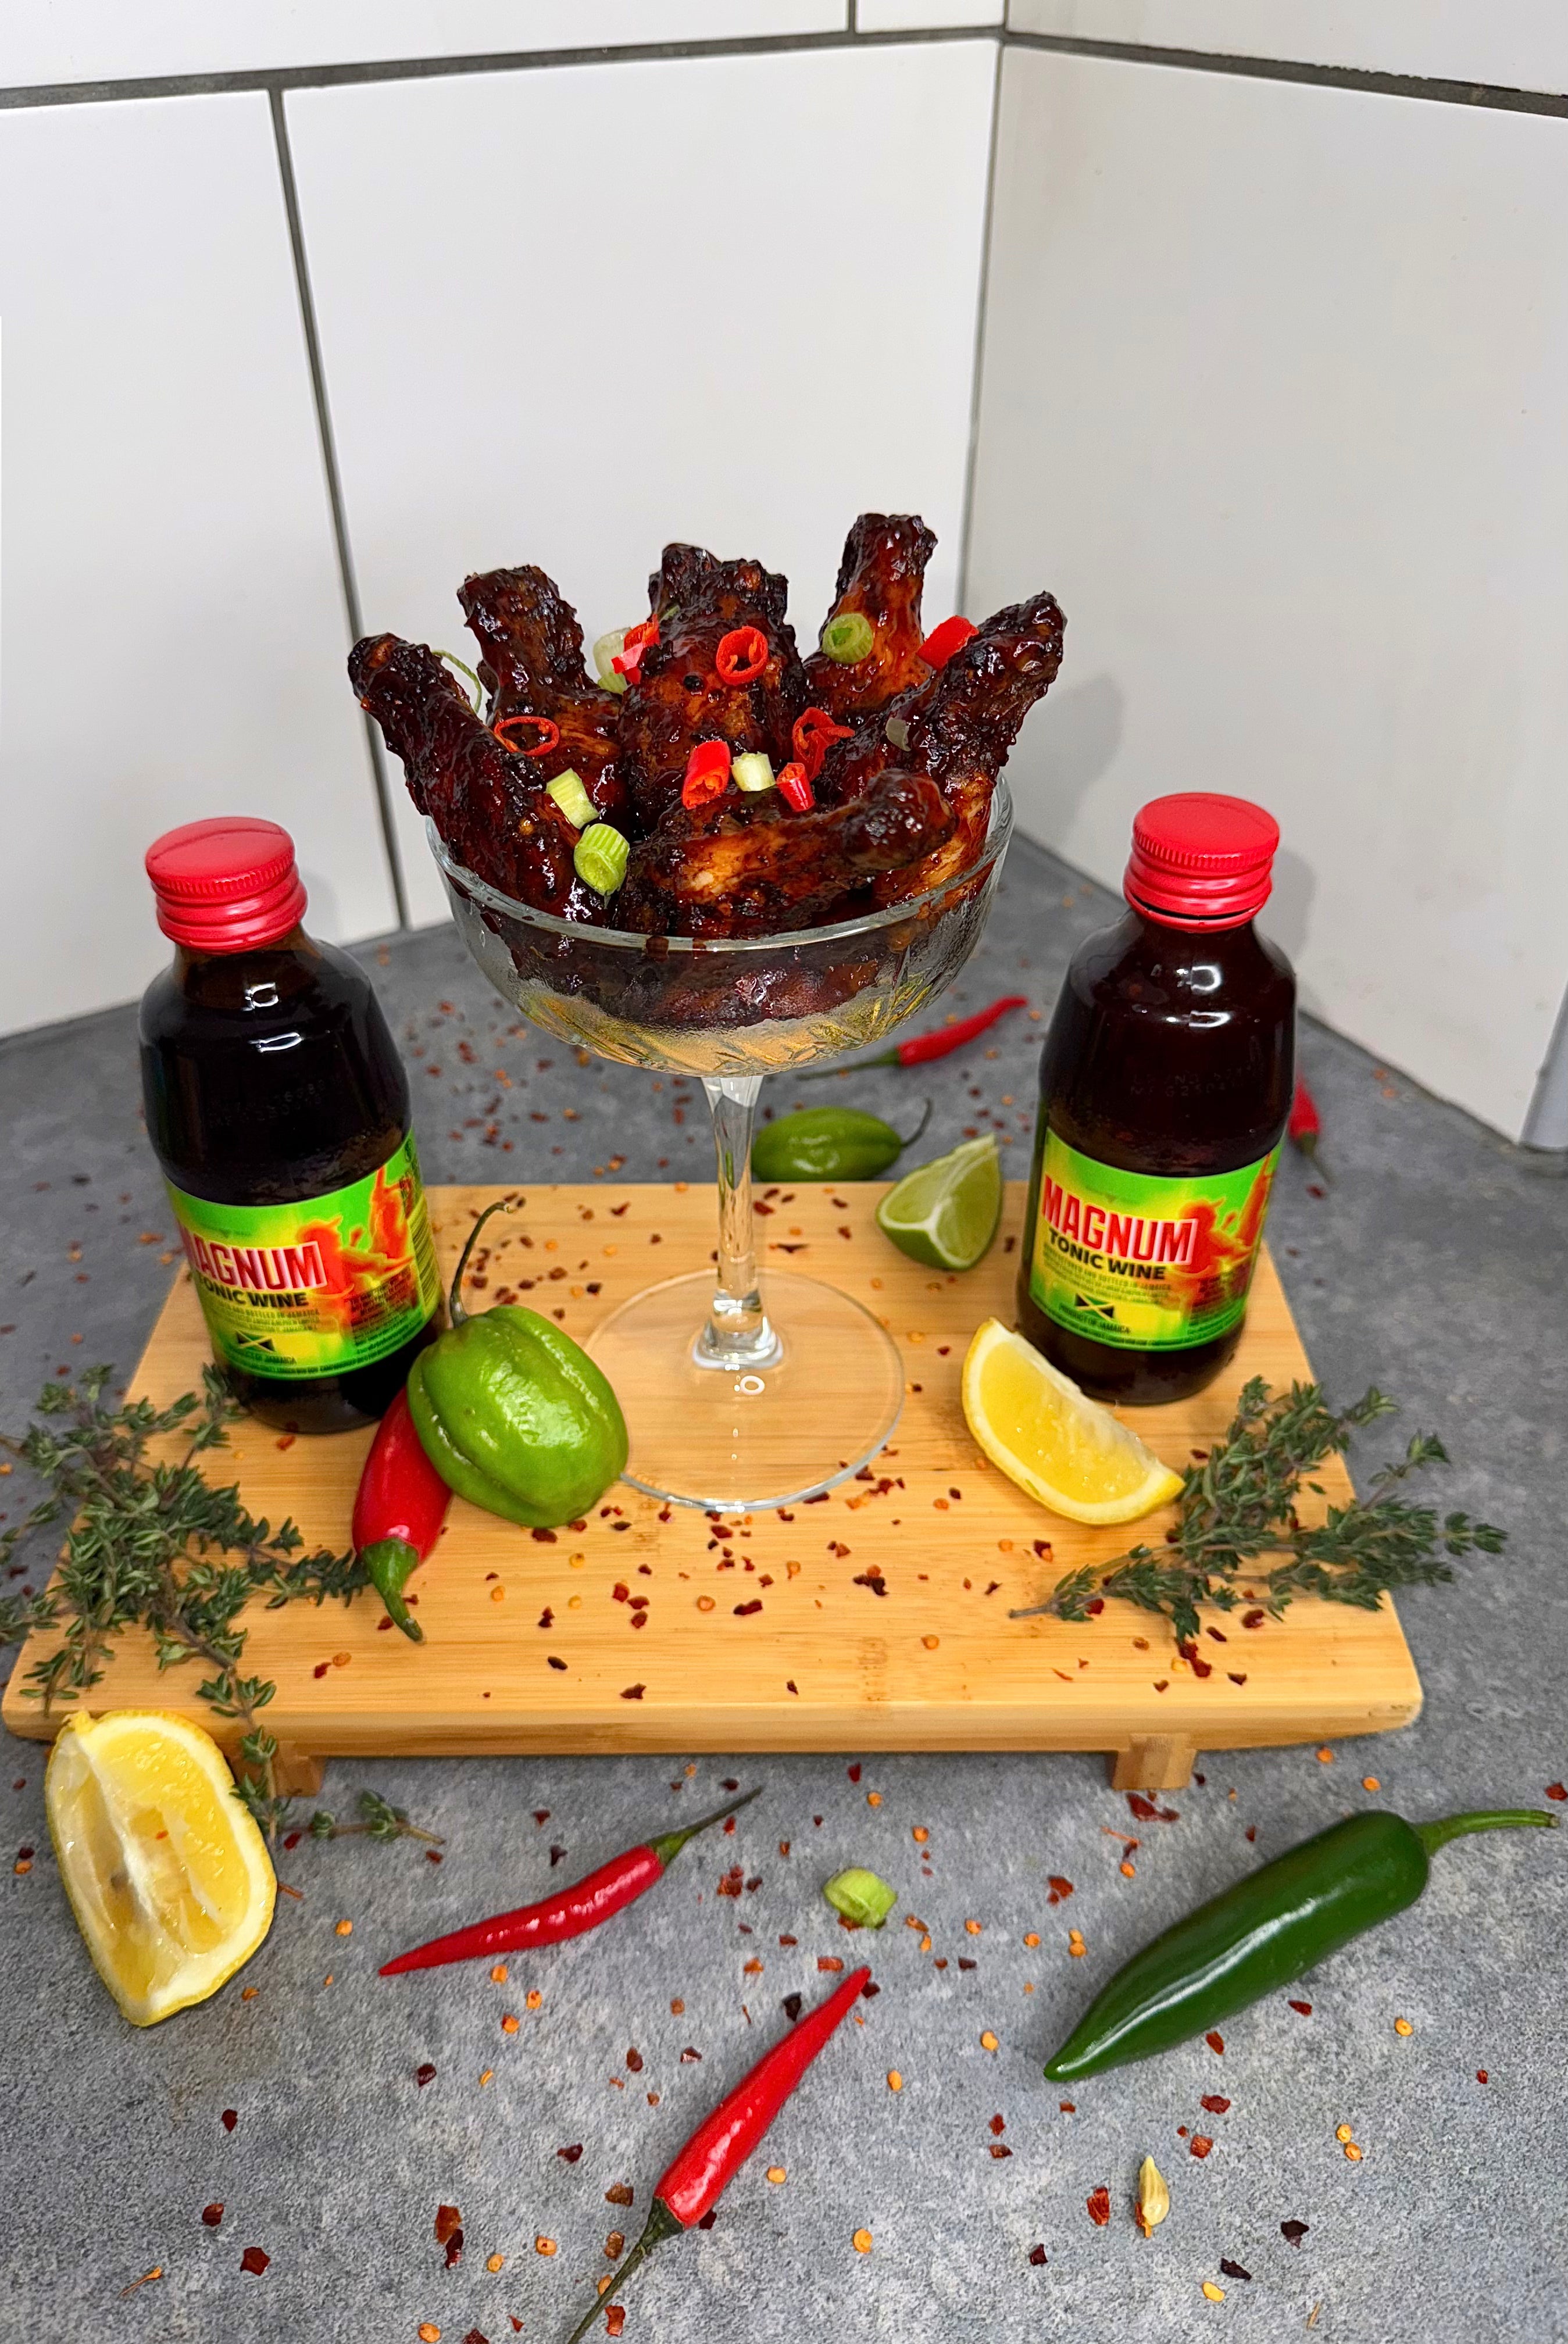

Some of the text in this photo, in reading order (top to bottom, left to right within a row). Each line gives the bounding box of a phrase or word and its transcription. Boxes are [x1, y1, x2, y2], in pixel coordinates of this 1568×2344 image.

[1042, 1174, 1198, 1265] MAGNUM
[1049, 1227, 1103, 1269] TONIC
[1108, 1259, 1167, 1279] WINE
[248, 1292, 309, 1307] WINE
[1098, 1320, 1131, 1334] JAMAICA
